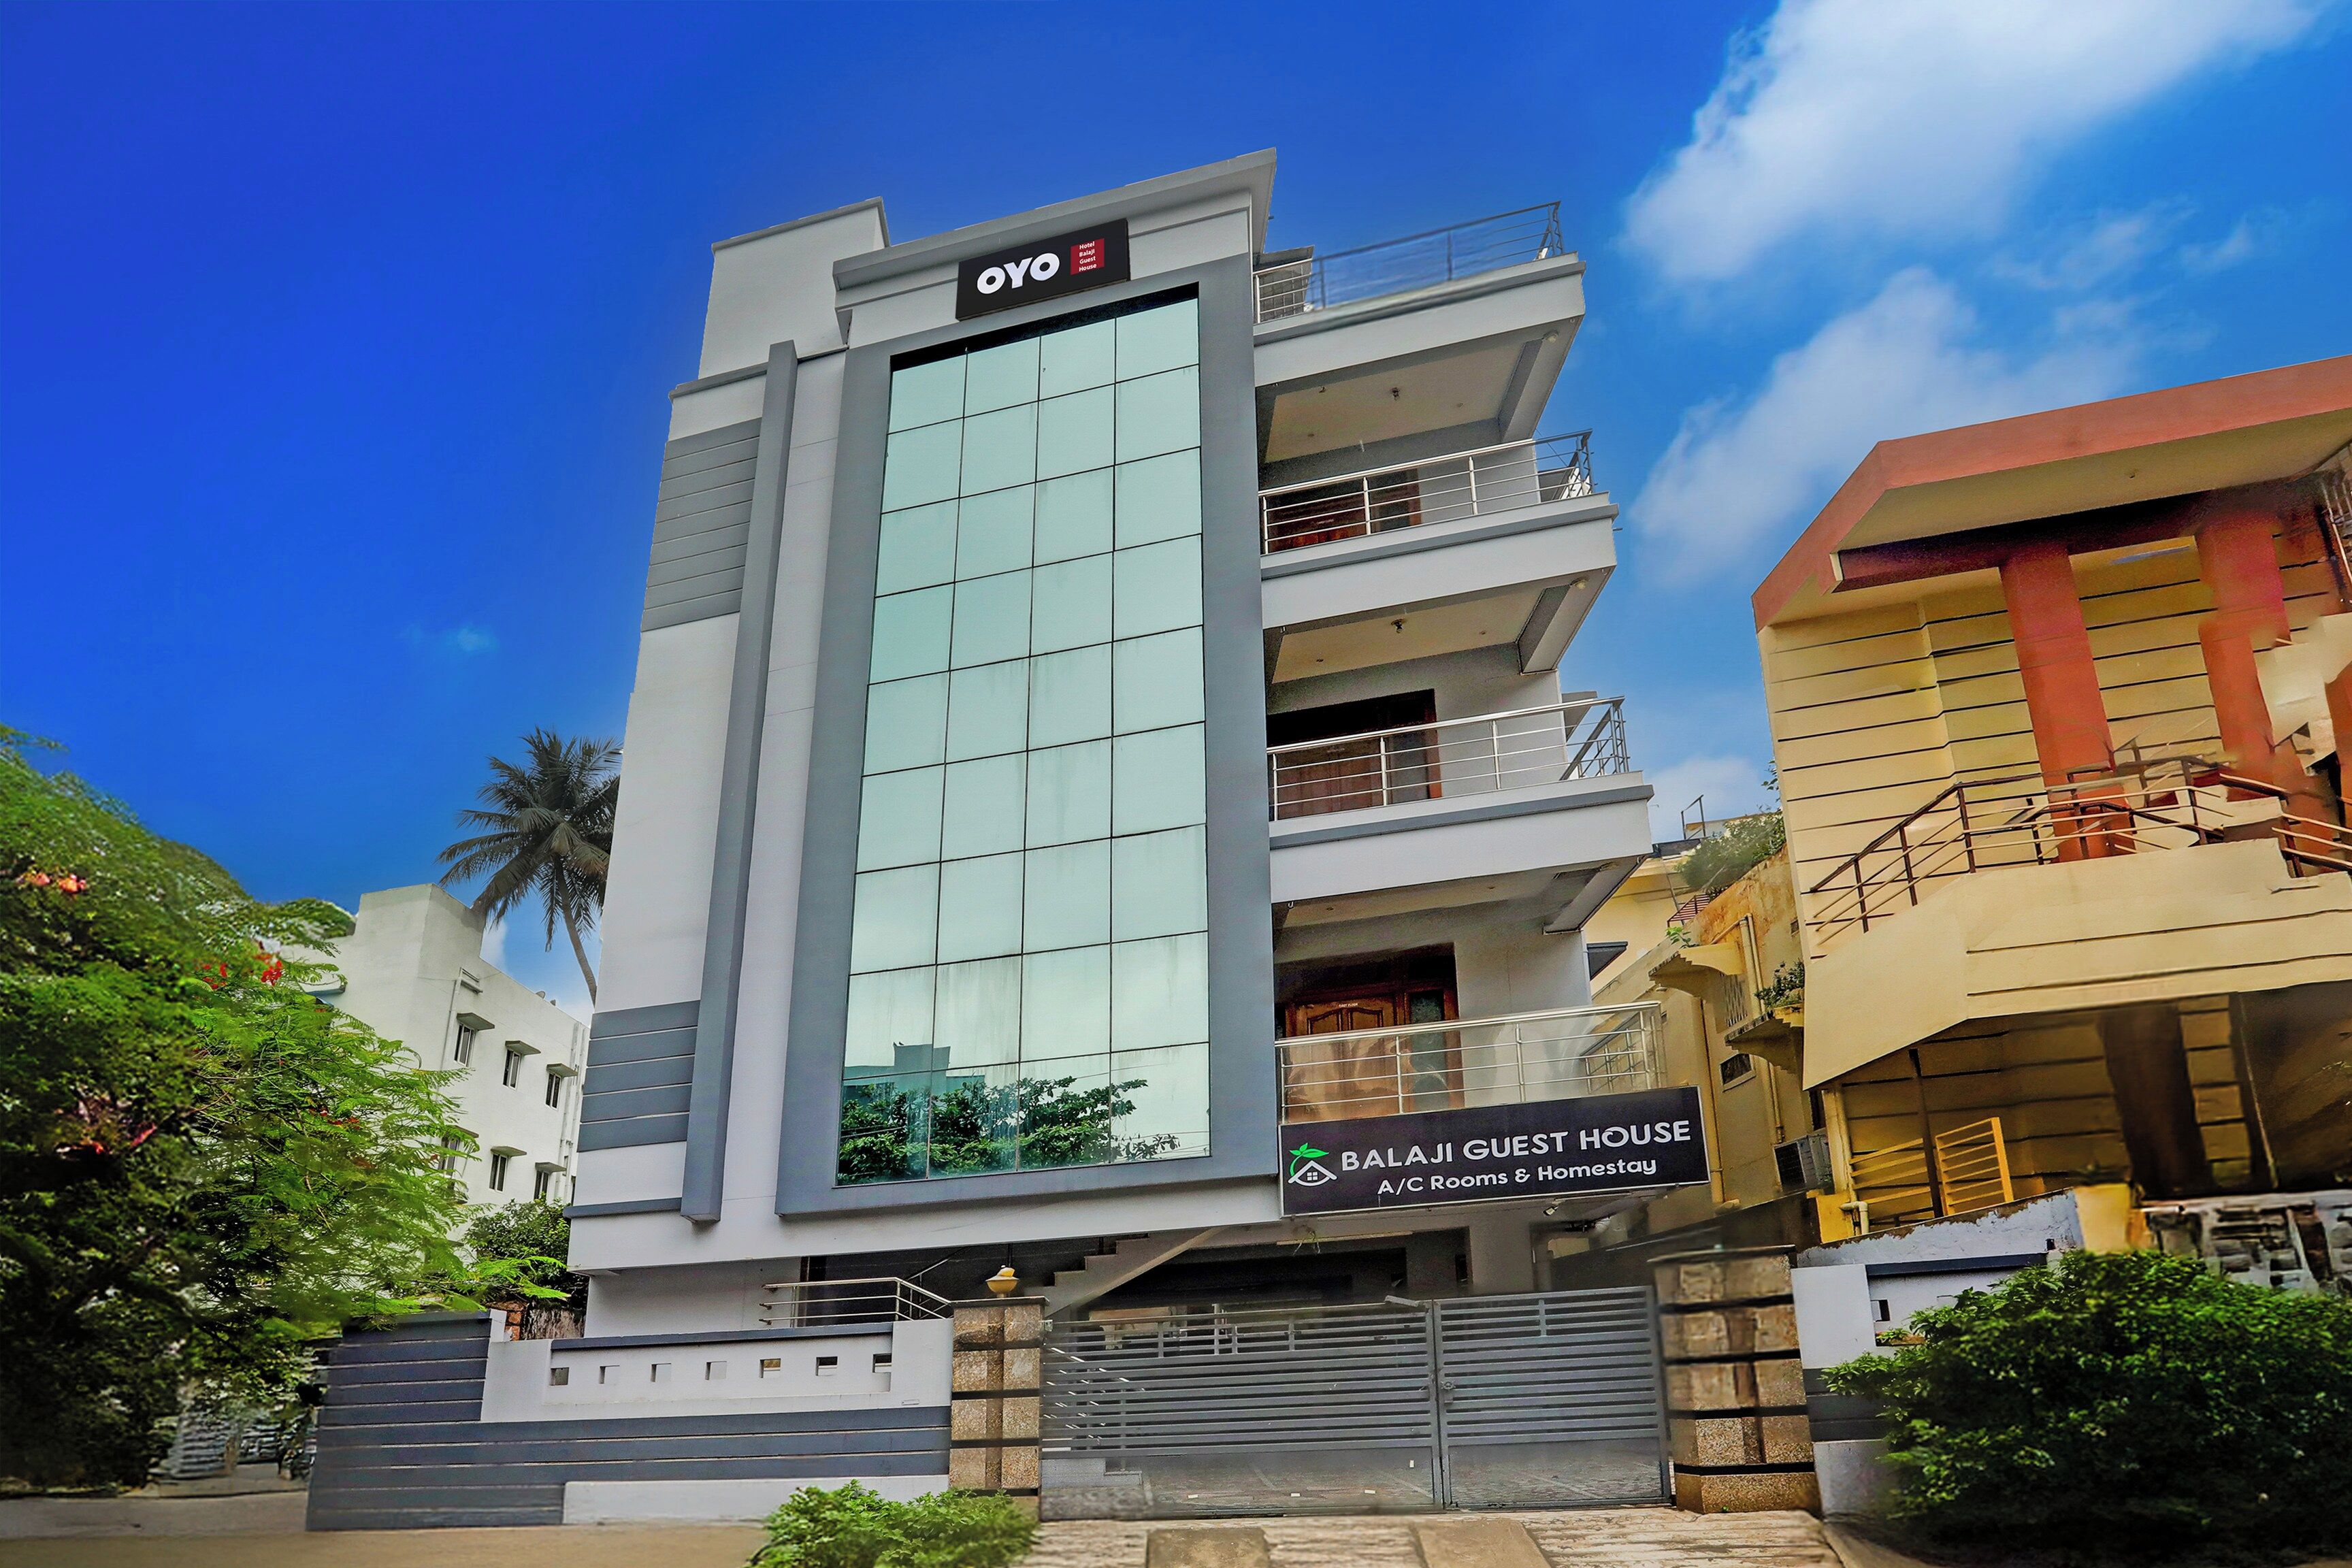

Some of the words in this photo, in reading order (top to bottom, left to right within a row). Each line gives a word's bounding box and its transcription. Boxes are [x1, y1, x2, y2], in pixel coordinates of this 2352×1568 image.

[1079, 241, 1095, 250] Hotel
[1079, 249, 1095, 257] Balaji
[1079, 256, 1096, 264] Guest
[1079, 263, 1096, 272] House
[977, 252, 1060, 294] OYO
[1341, 1142, 1454, 1172] BALAJI
[1463, 1131, 1569, 1160] GUEST
[1580, 1120, 1691, 1150] HOUSE
[1377, 1177, 1424, 1196] A/C
[1431, 1171, 1507, 1190] Rooms
[1515, 1169, 1531, 1183] &
[1538, 1158, 1657, 1181] Homestay
